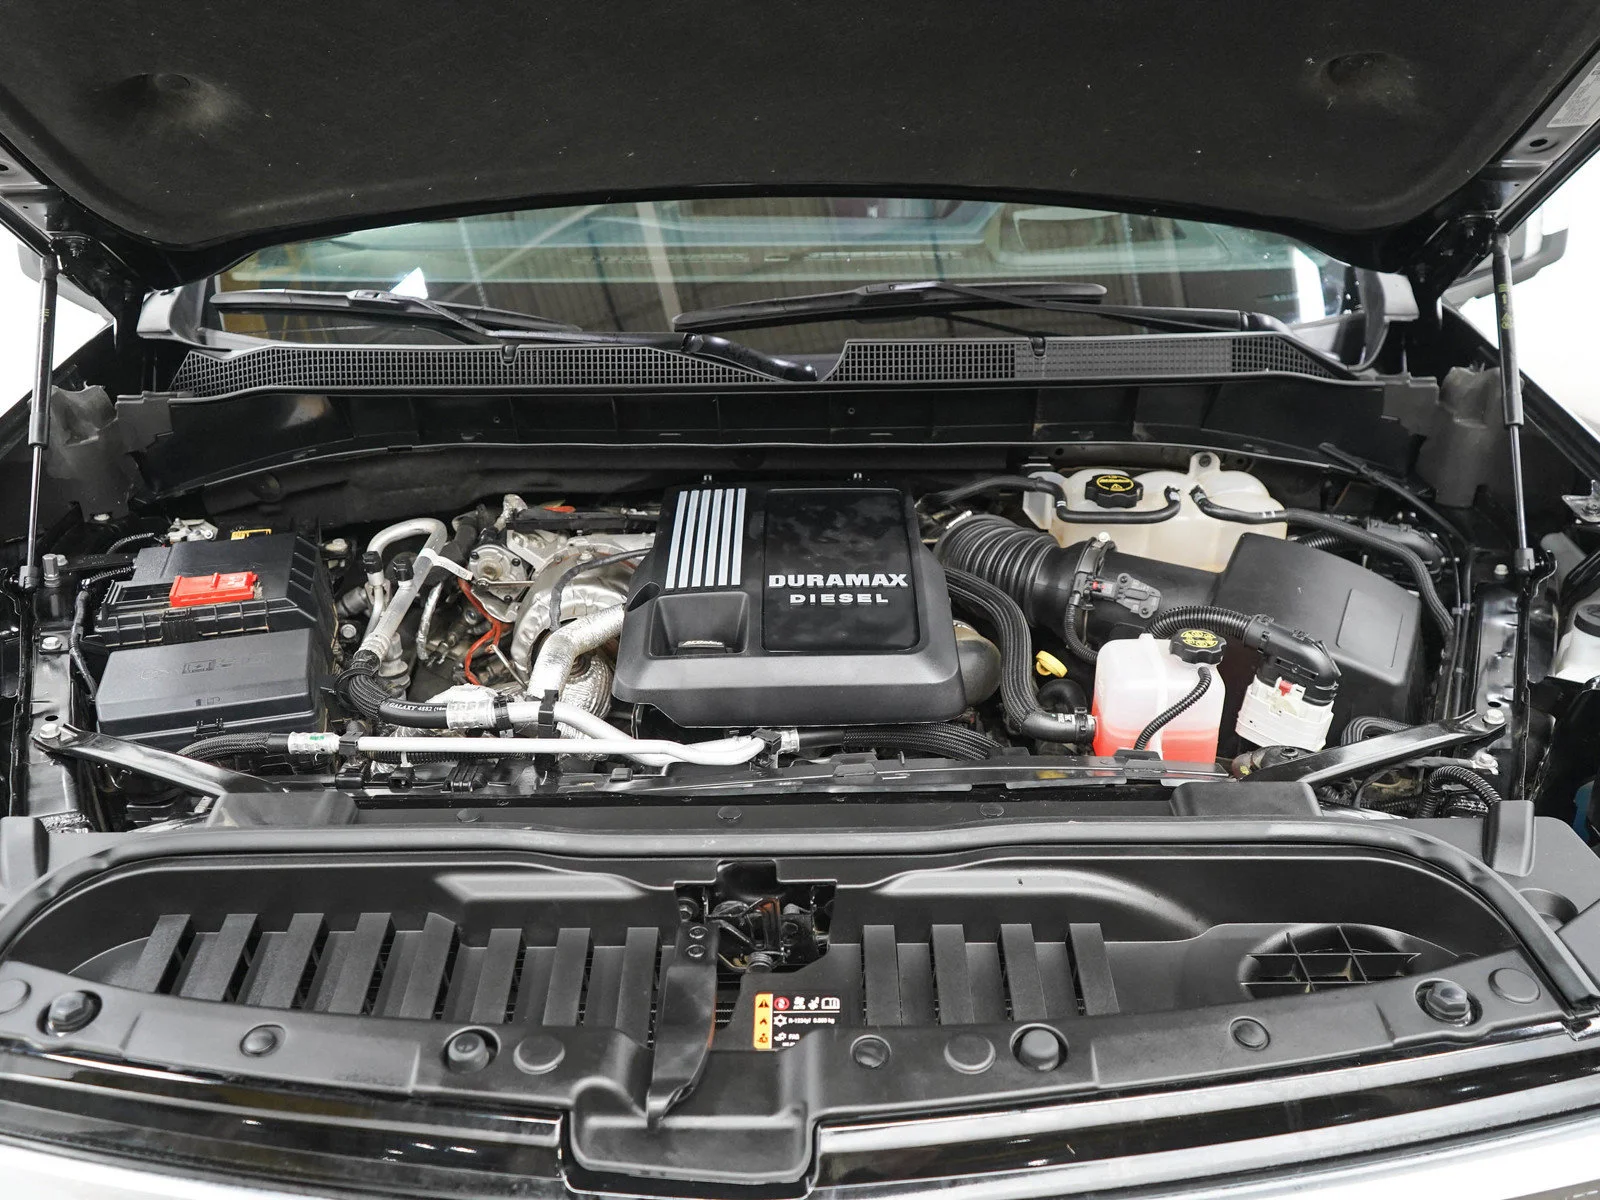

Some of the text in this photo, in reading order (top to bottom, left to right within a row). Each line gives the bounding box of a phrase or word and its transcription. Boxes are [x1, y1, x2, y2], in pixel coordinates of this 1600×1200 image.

[768, 573, 909, 588] DURAMAX
[789, 593, 889, 605] DIESEL
[389, 702, 418, 711] GALAXY
